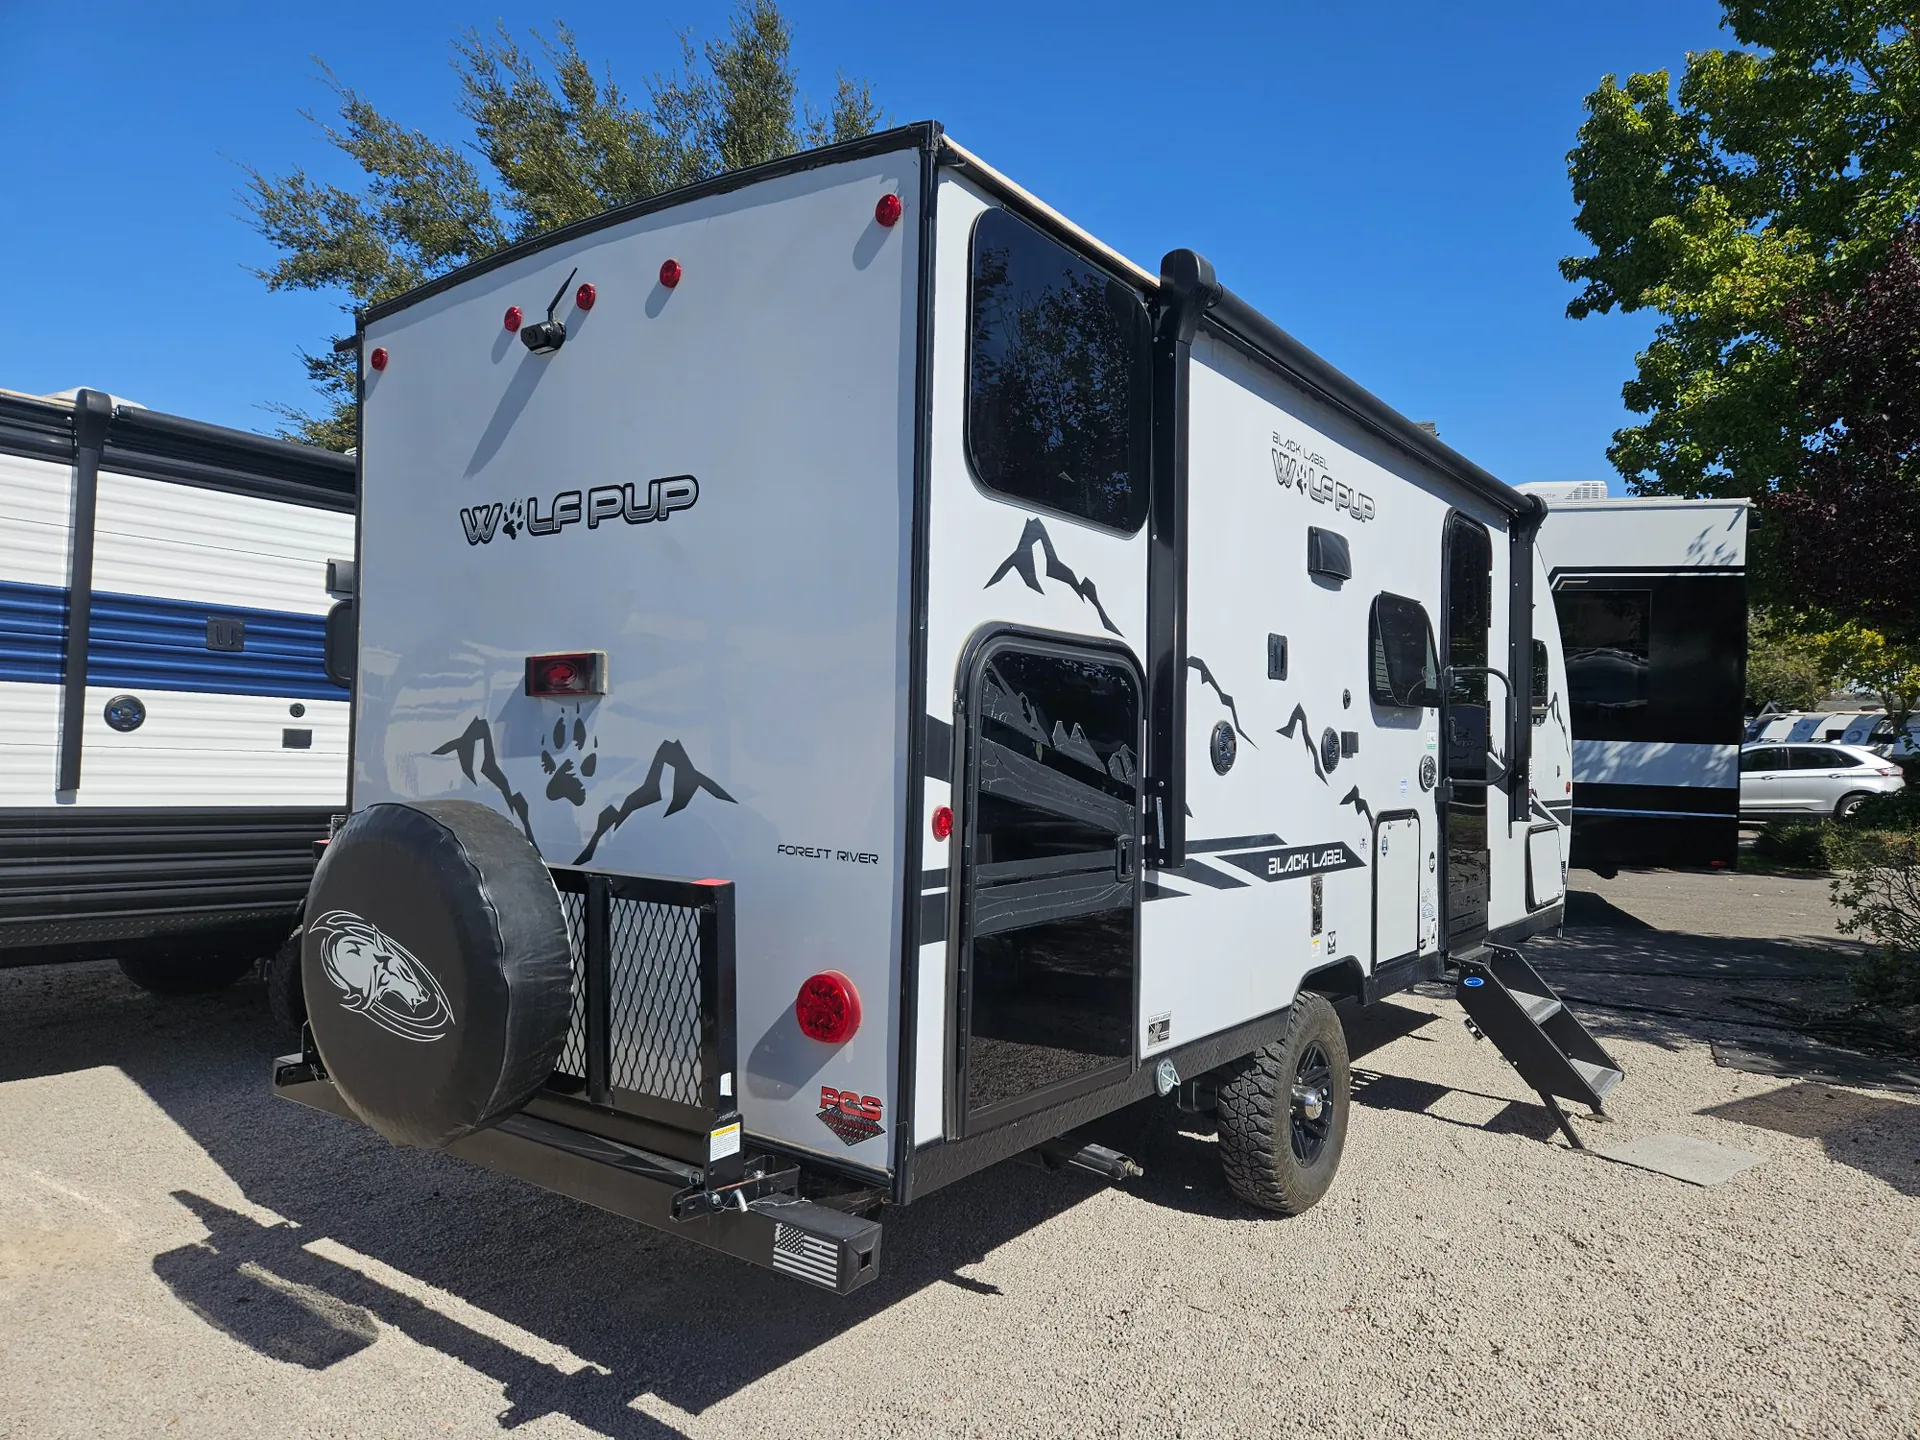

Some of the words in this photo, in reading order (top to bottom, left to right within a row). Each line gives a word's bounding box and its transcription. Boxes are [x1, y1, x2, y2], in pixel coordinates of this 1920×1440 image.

[1272, 431, 1302, 456] BLACK
[1303, 447, 1329, 471] LABEL
[587, 474, 700, 530] PUP
[1335, 481, 1376, 523] PUP
[777, 844, 832, 860] FOREST
[836, 850, 880, 865] RIVER
[1268, 853, 1310, 875] BLACK
[1312, 848, 1347, 869] LABEL
[819, 1086, 884, 1122] PCS
